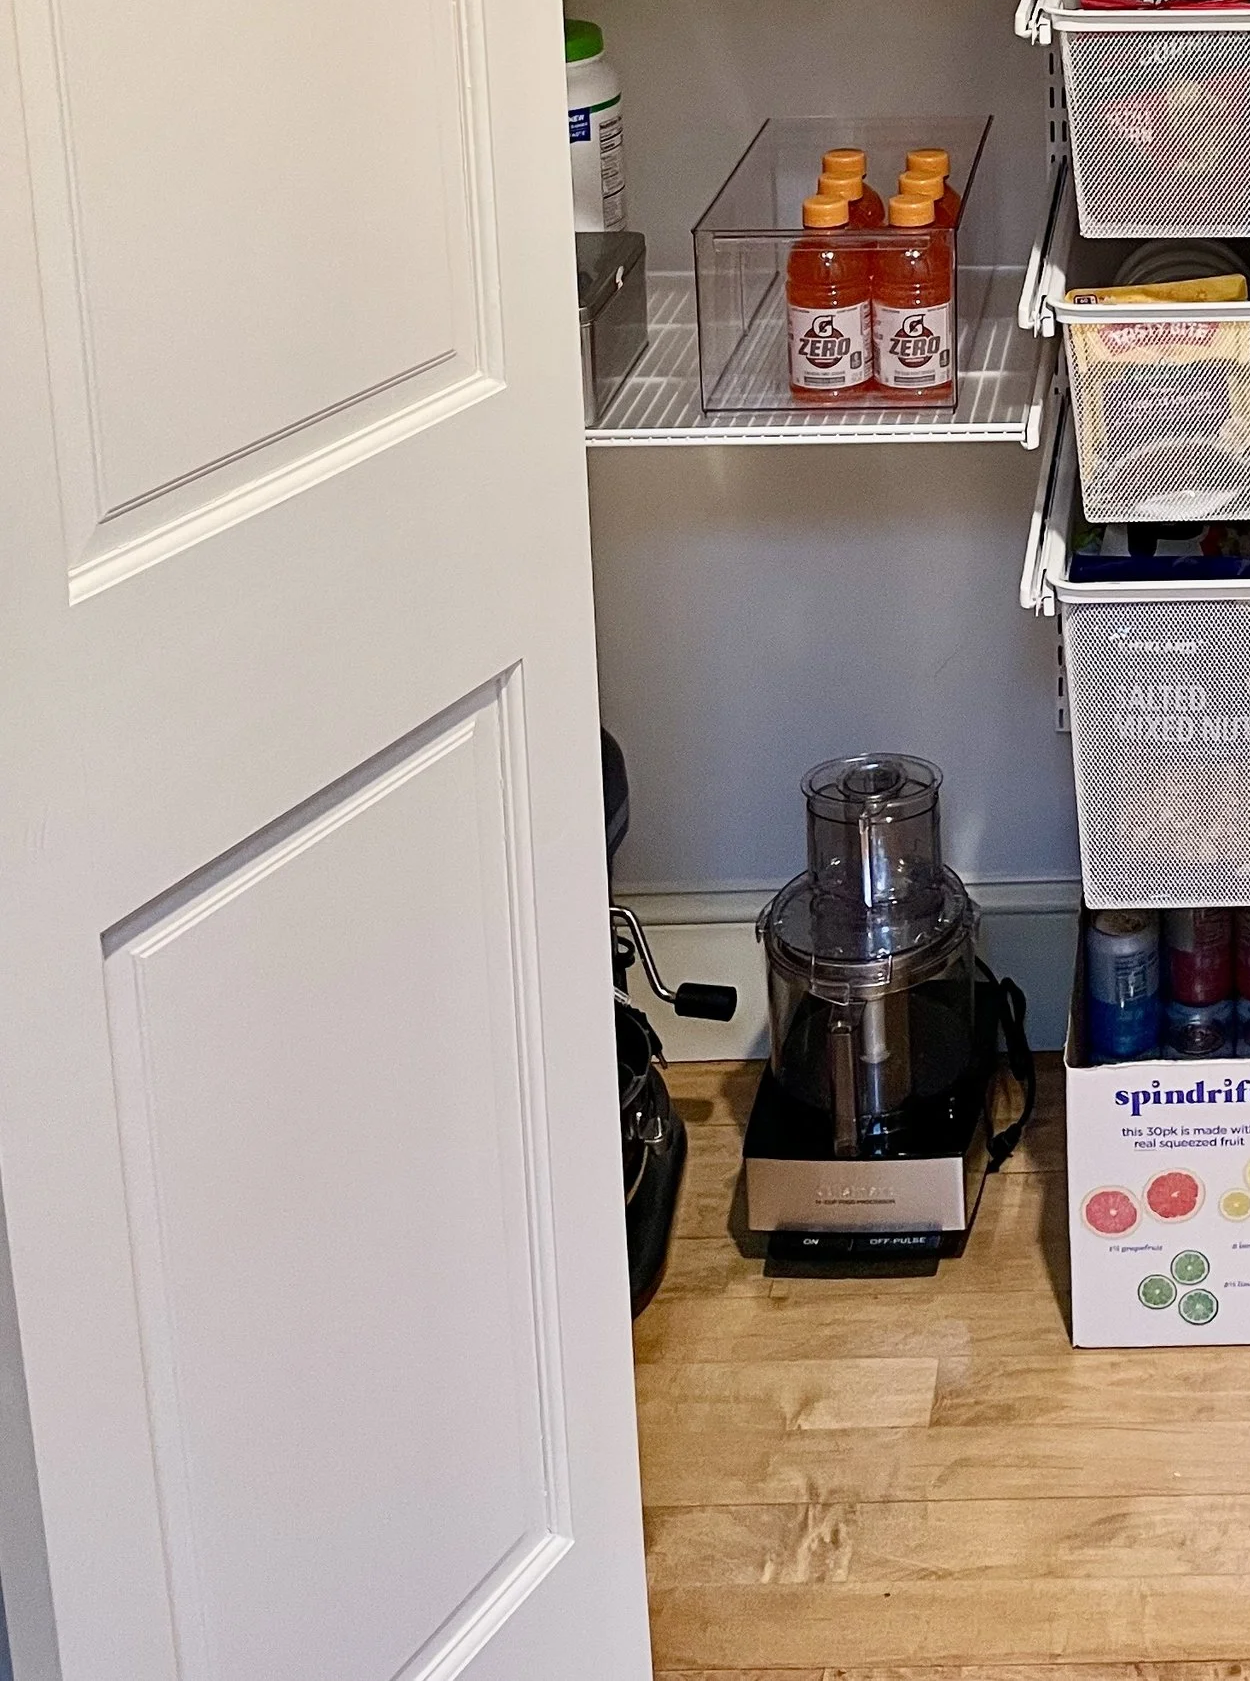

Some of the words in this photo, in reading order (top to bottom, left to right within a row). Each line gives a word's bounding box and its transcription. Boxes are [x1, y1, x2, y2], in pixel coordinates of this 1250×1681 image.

[798, 337, 851, 358] ZERO
[888, 336, 941, 357] ZERO
[1113, 714, 1196, 744] MIXED
[1121, 1127, 1144, 1137] this
[1146, 1126, 1178, 1140] 30pk
[1180, 1126, 1190, 1136] is
[1193, 1125, 1228, 1136] made
[1134, 1138, 1157, 1149] real
[1158, 1137, 1217, 1150] squeezed
[1220, 1136, 1245, 1147] fruit
[802, 1238, 819, 1246] ON
